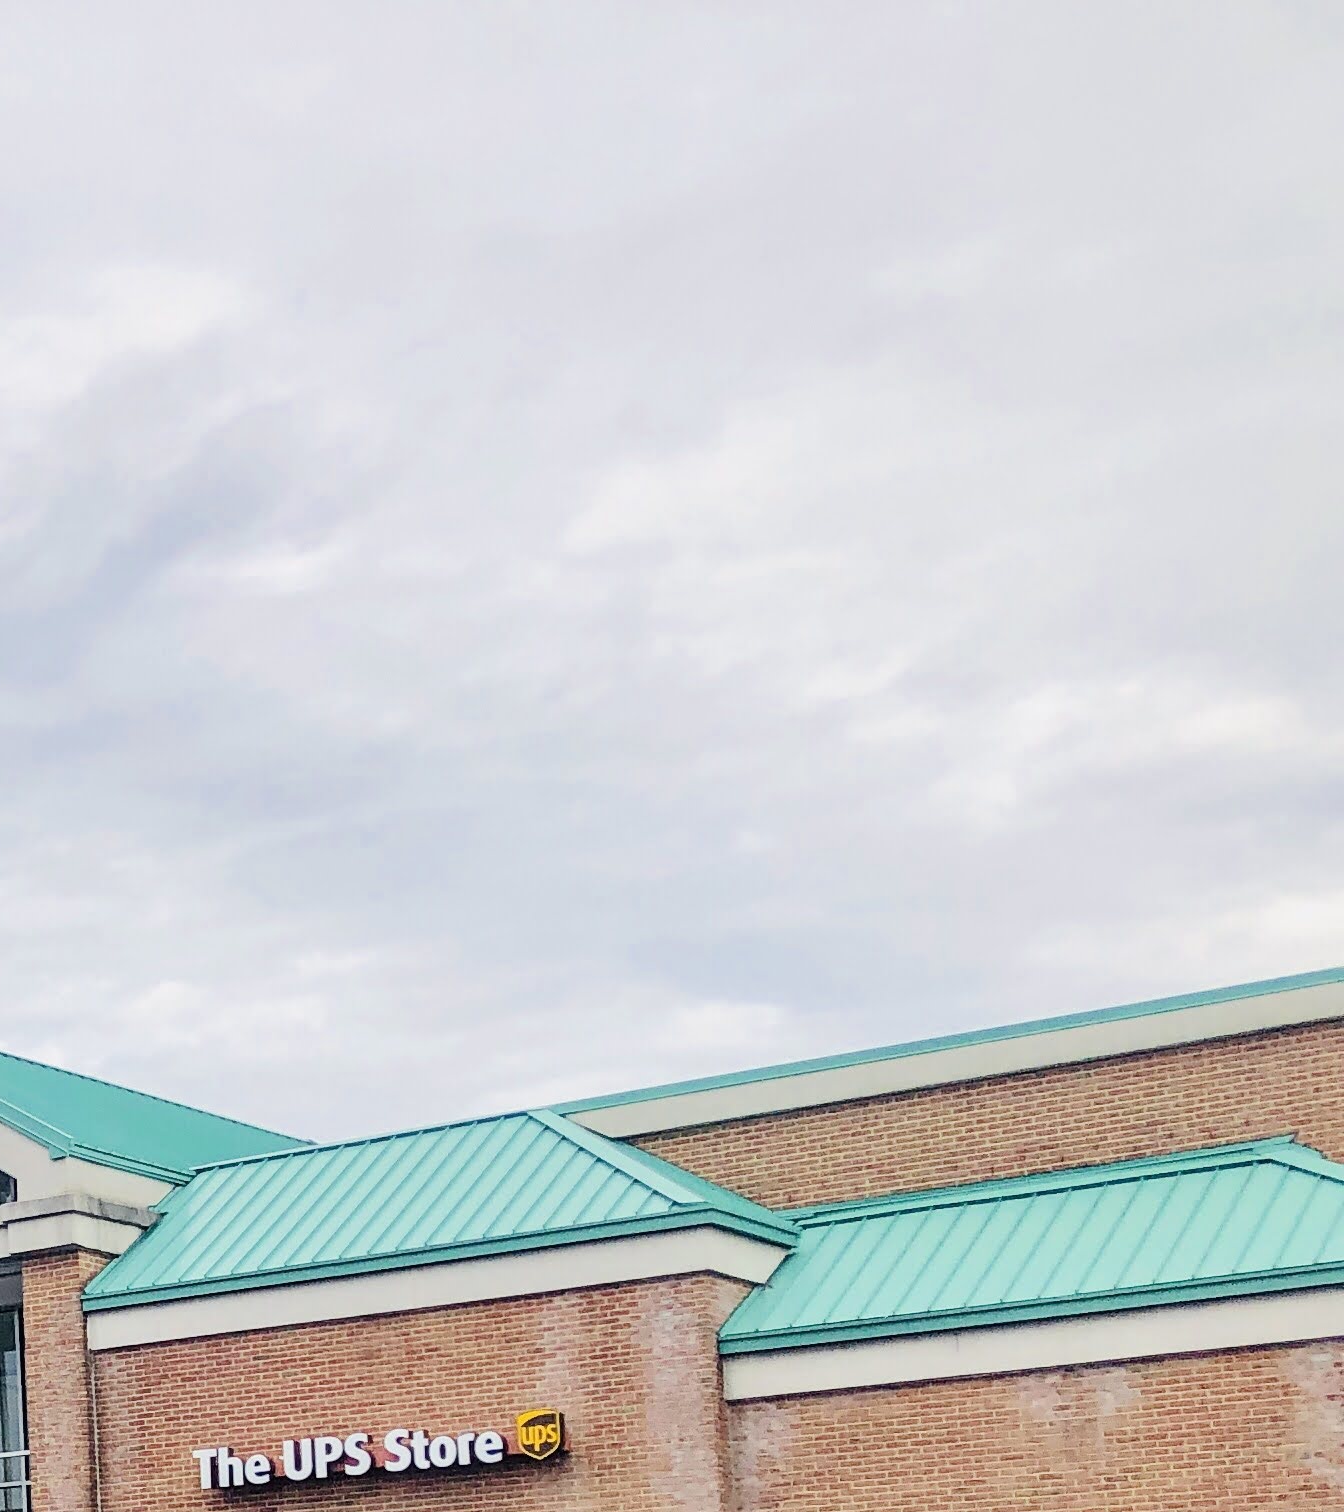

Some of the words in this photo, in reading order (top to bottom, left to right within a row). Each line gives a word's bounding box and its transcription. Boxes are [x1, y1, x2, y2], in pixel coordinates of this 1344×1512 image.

[192, 1446, 271, 1489] The
[279, 1433, 372, 1481] UPS
[383, 1428, 504, 1472] Store
